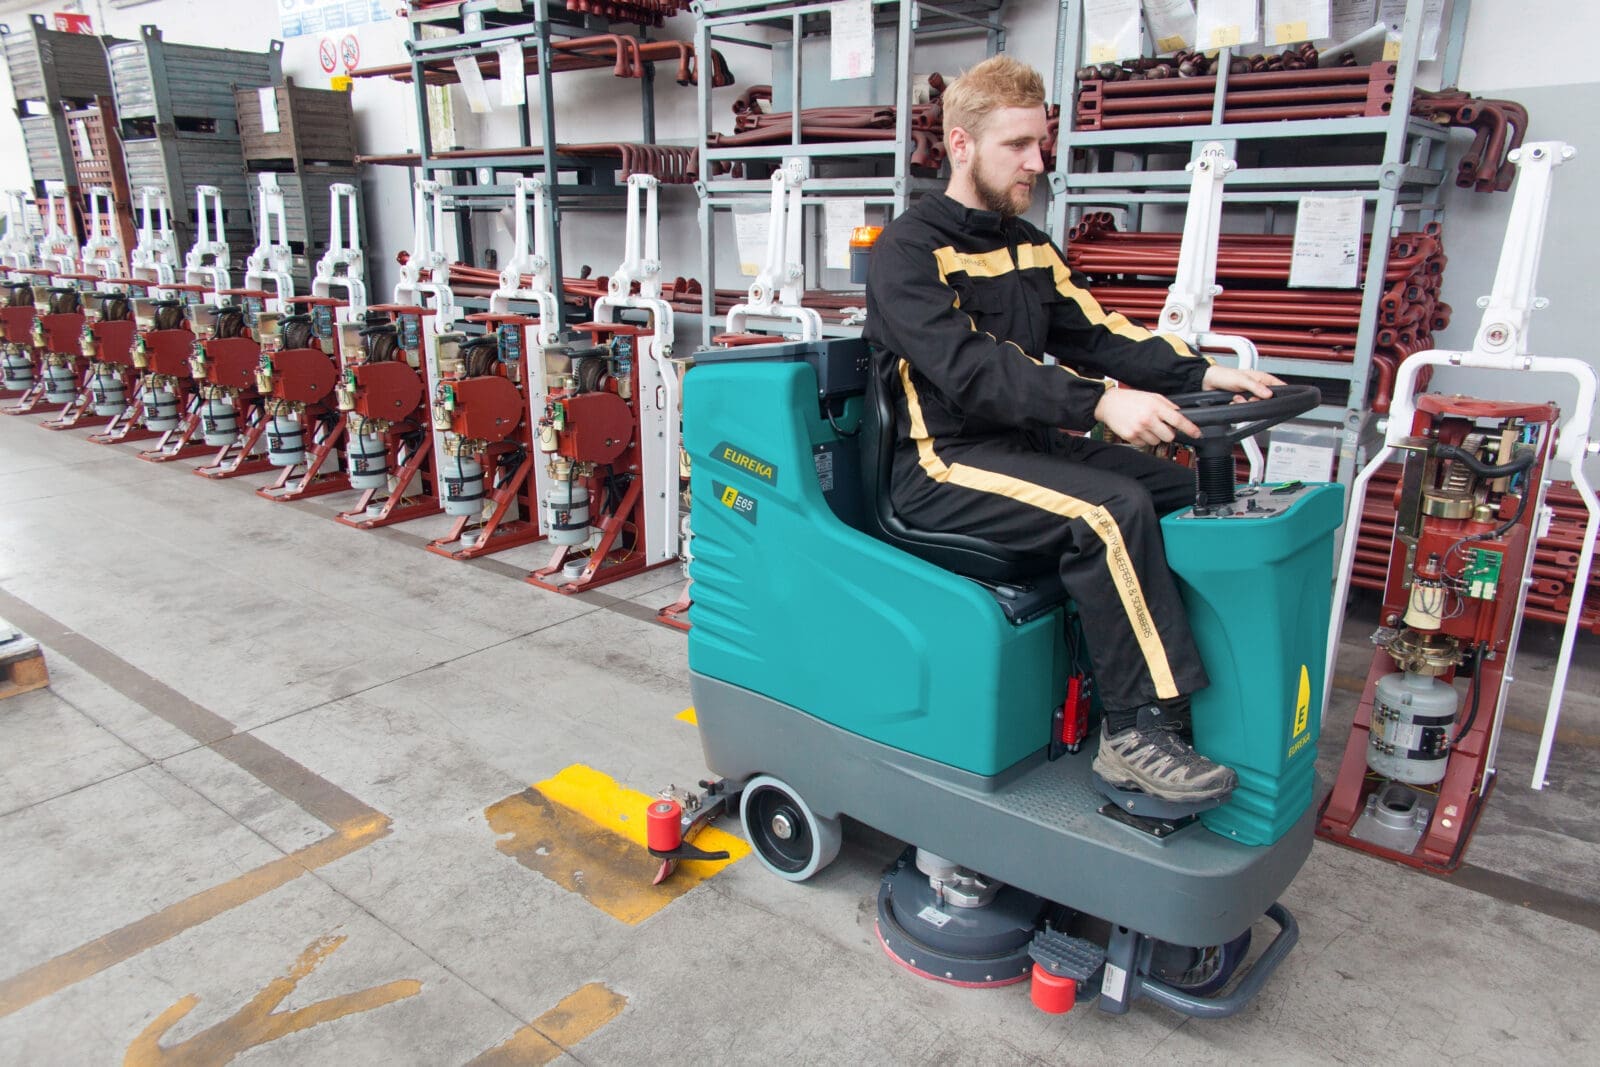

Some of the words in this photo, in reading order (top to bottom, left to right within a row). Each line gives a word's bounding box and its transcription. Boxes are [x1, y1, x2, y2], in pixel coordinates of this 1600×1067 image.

[723, 447, 773, 480] EUREKA
[735, 496, 754, 511] E65
[1112, 546, 1134, 588] SWEEPERS
[1132, 596, 1153, 639] SCRUBBERS
